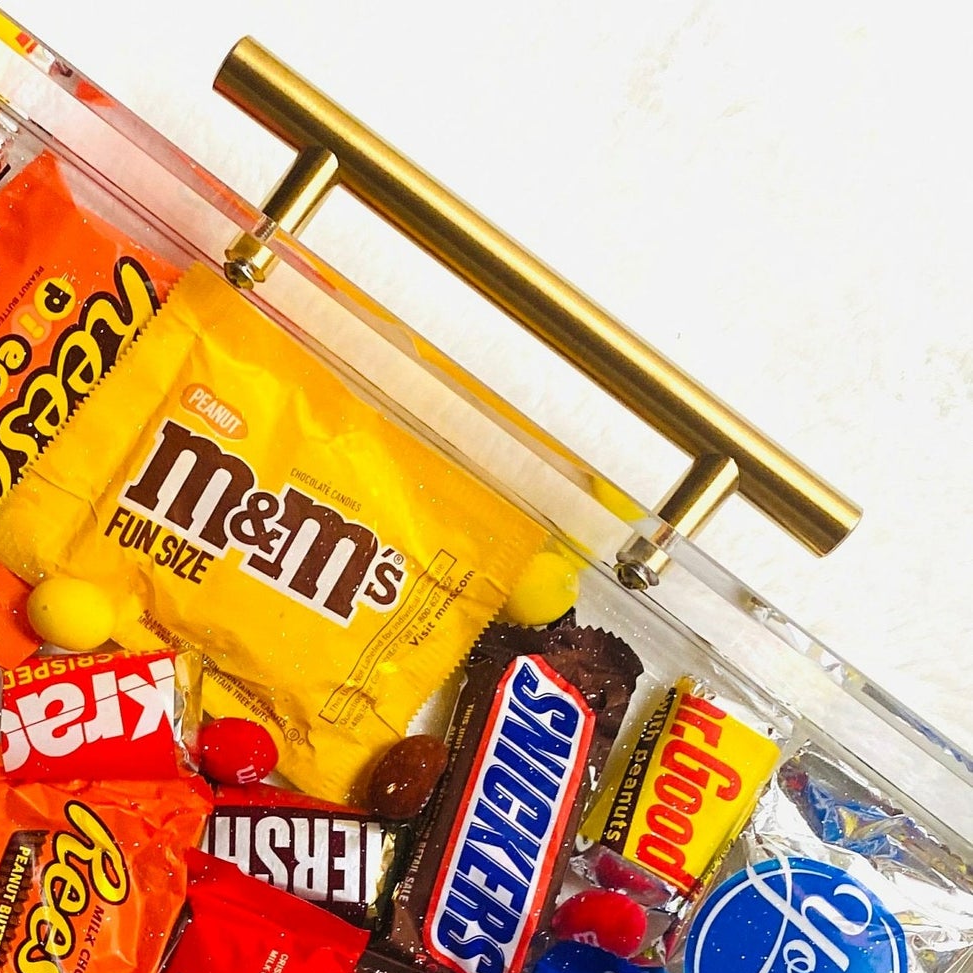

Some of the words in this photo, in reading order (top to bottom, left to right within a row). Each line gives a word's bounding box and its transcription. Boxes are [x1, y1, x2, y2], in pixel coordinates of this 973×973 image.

[16, 264, 45, 298] PEANUT
[188, 388, 243, 434] PEANUT
[288, 466, 332, 496] CHOCOLATE
[329, 488, 363, 513] CANDIES
[104, 509, 162, 555] FUN
[155, 535, 215, 585] SIZE
[407, 619, 436, 649] Visit
[604, 746, 650, 844] peanuts
[636, 694, 742, 897] r.Good
[0, 845, 32, 903] PEANUT
[398, 875, 413, 901] SALE
[82, 905, 107, 945] MILK
[262, 948, 278, 972] MILK
